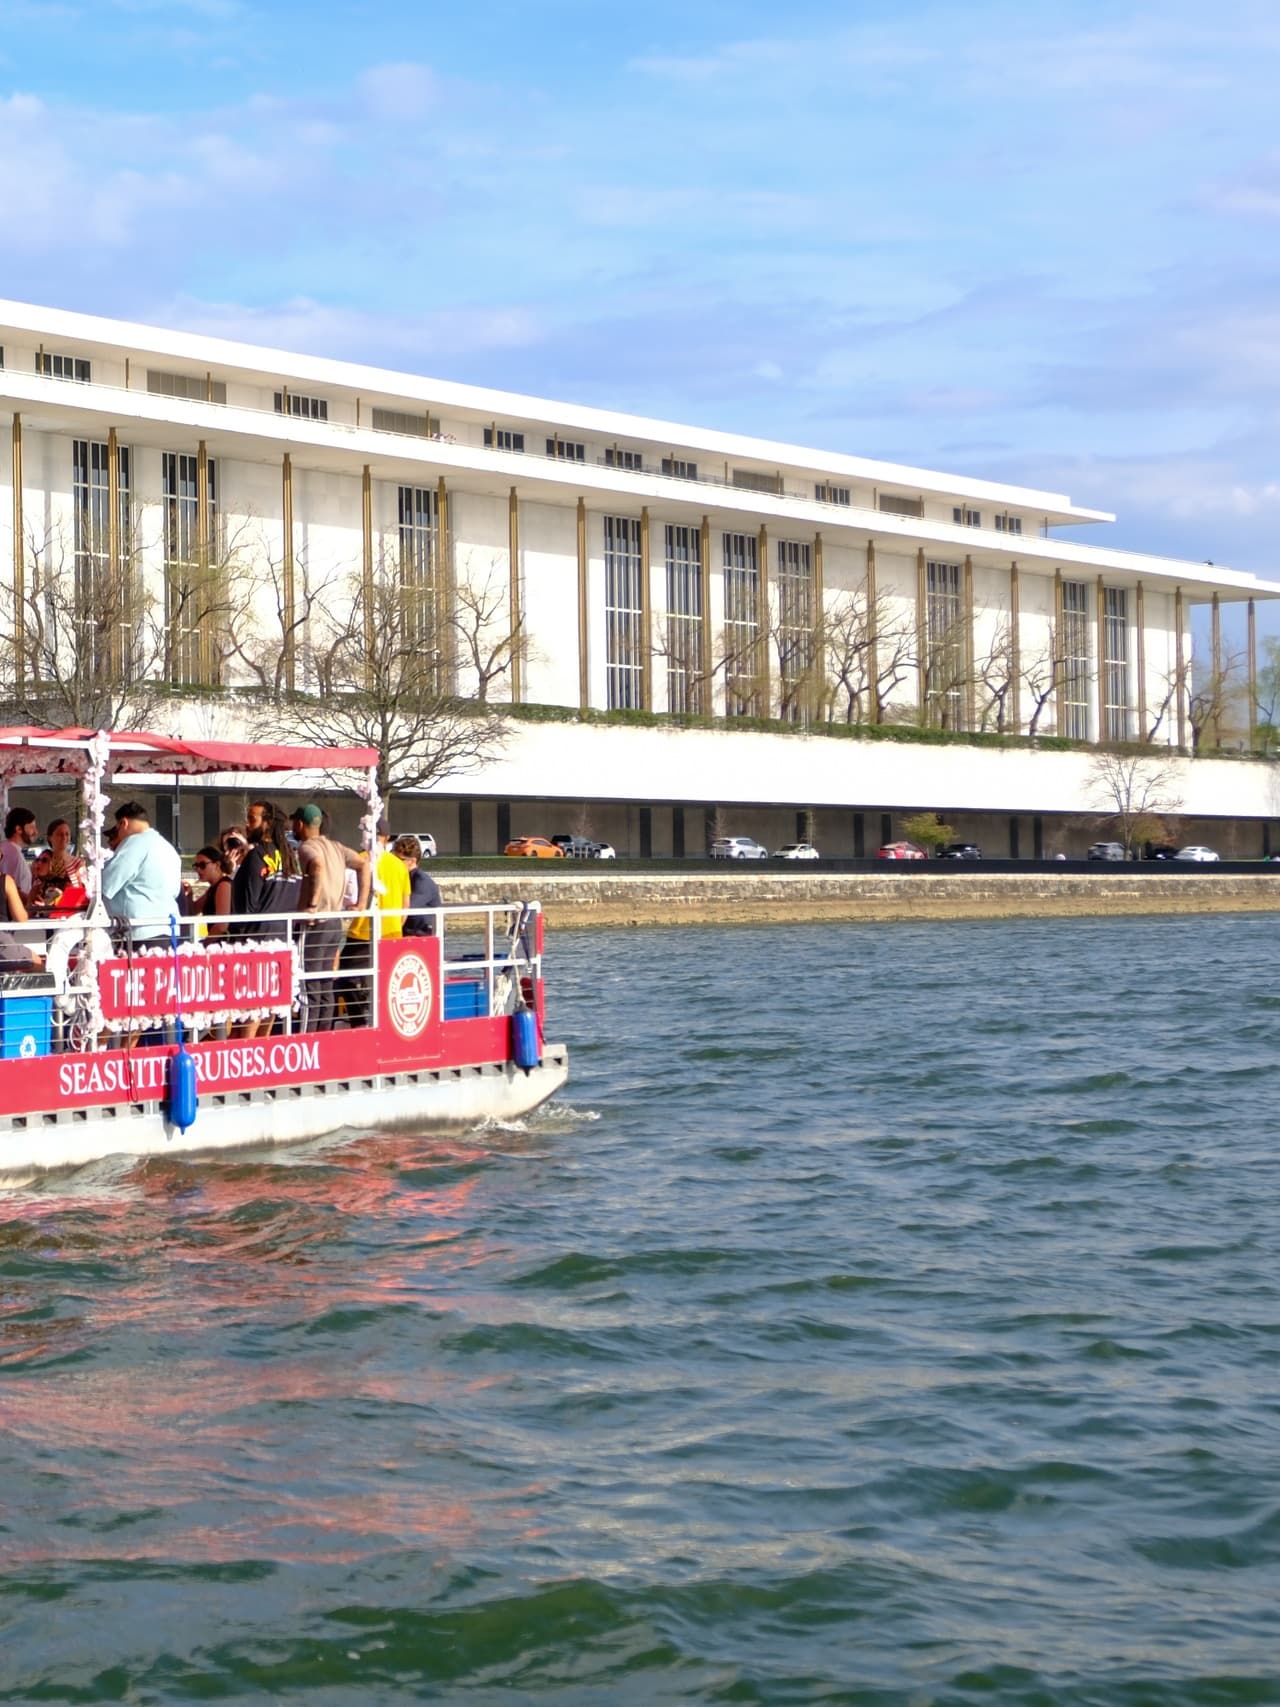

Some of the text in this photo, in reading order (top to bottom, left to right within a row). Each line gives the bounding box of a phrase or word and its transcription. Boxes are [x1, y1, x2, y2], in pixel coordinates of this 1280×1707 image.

[110, 961, 281, 1008] THE PADDLE CLUB
[59, 1041, 320, 1096] SEASUITERUISES.COM
